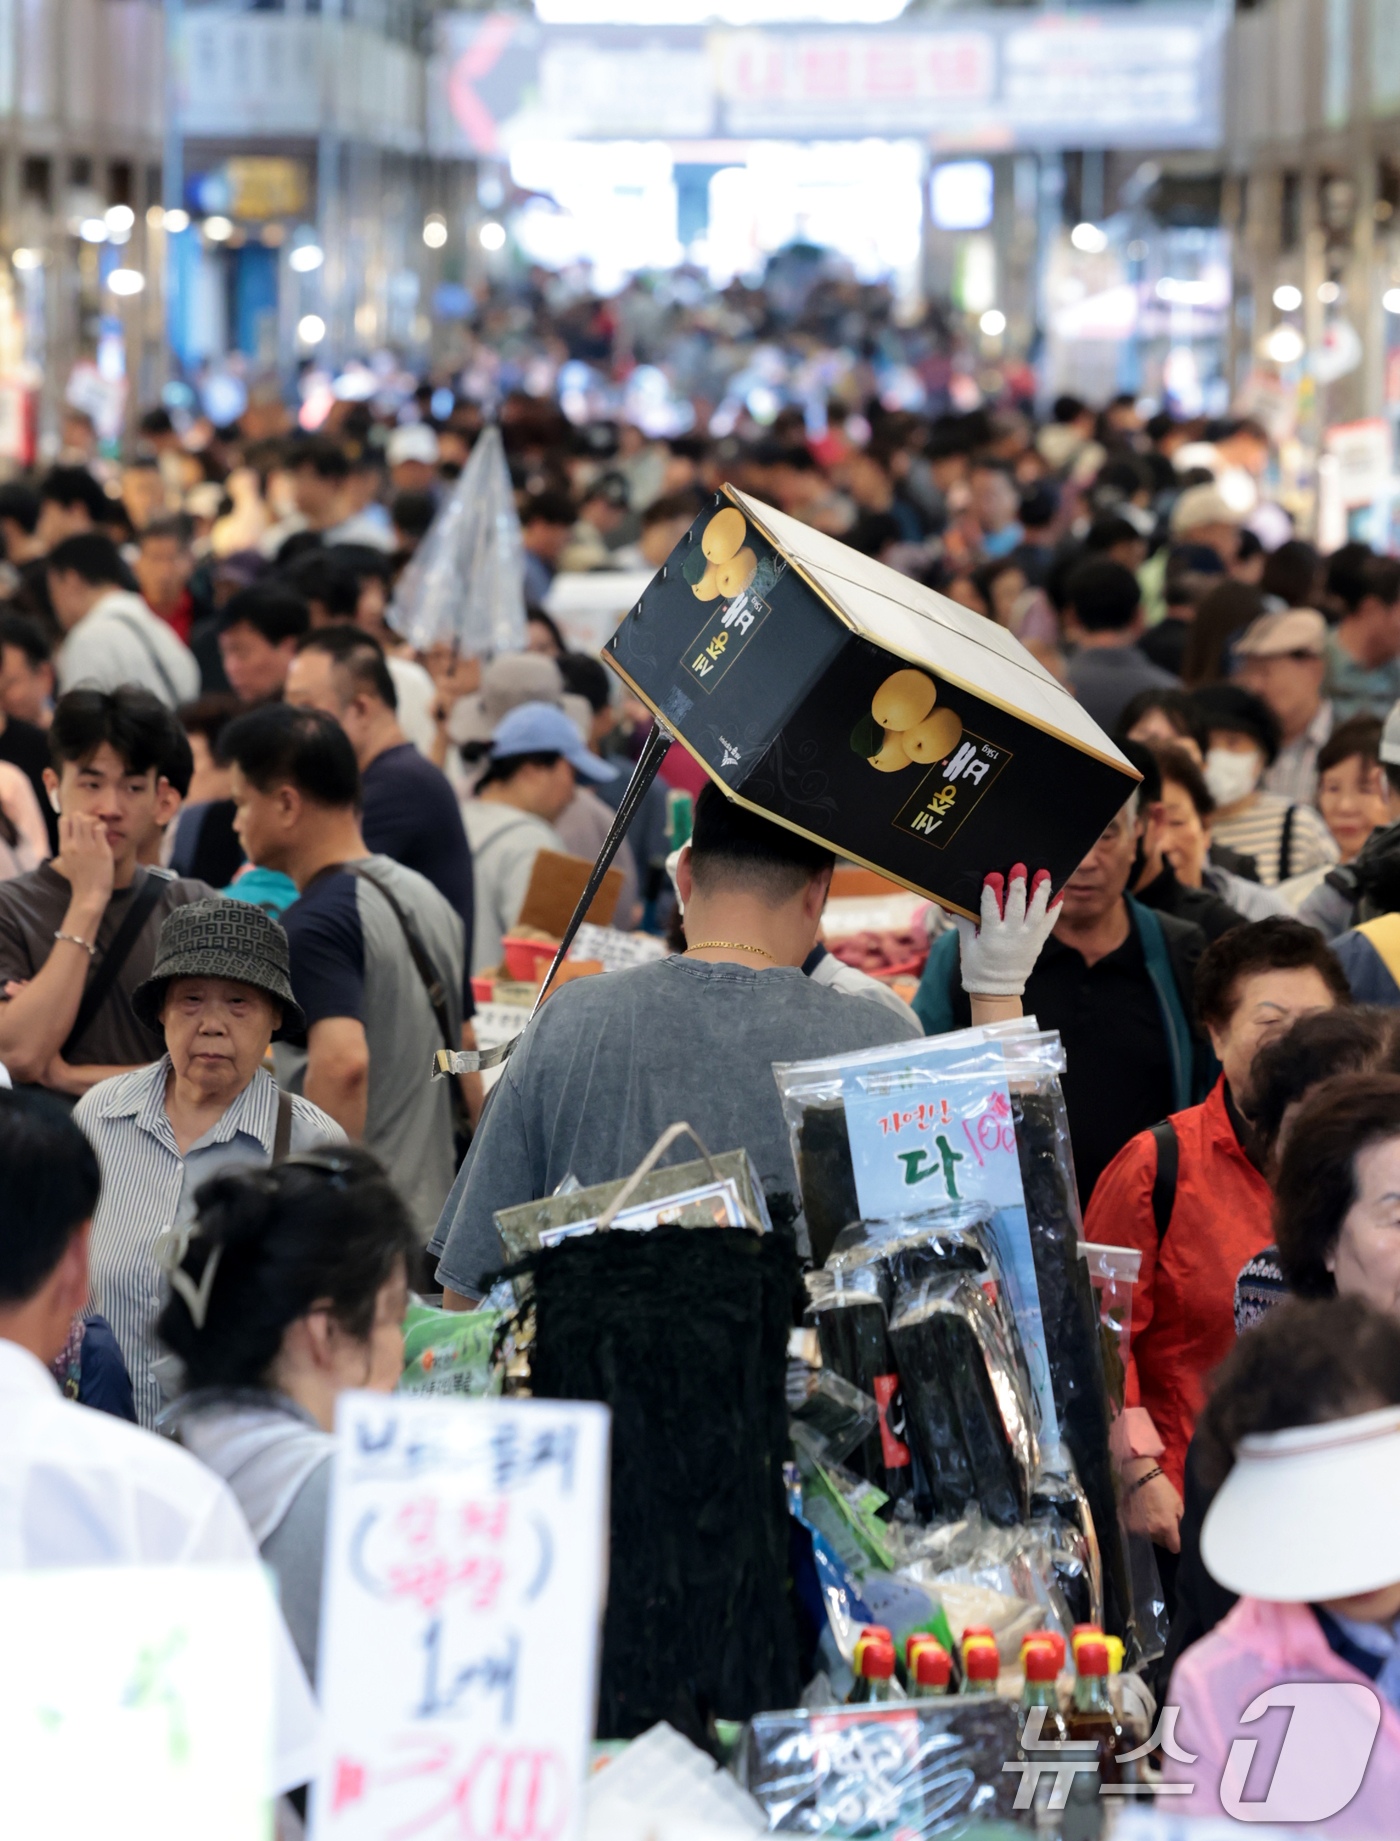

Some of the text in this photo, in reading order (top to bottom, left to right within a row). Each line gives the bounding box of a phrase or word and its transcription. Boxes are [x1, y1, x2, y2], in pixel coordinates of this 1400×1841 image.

[750, 595, 764, 613] 15kg
[981, 743, 999, 760] 15kg
[877, 1099, 955, 1135] 자연산
